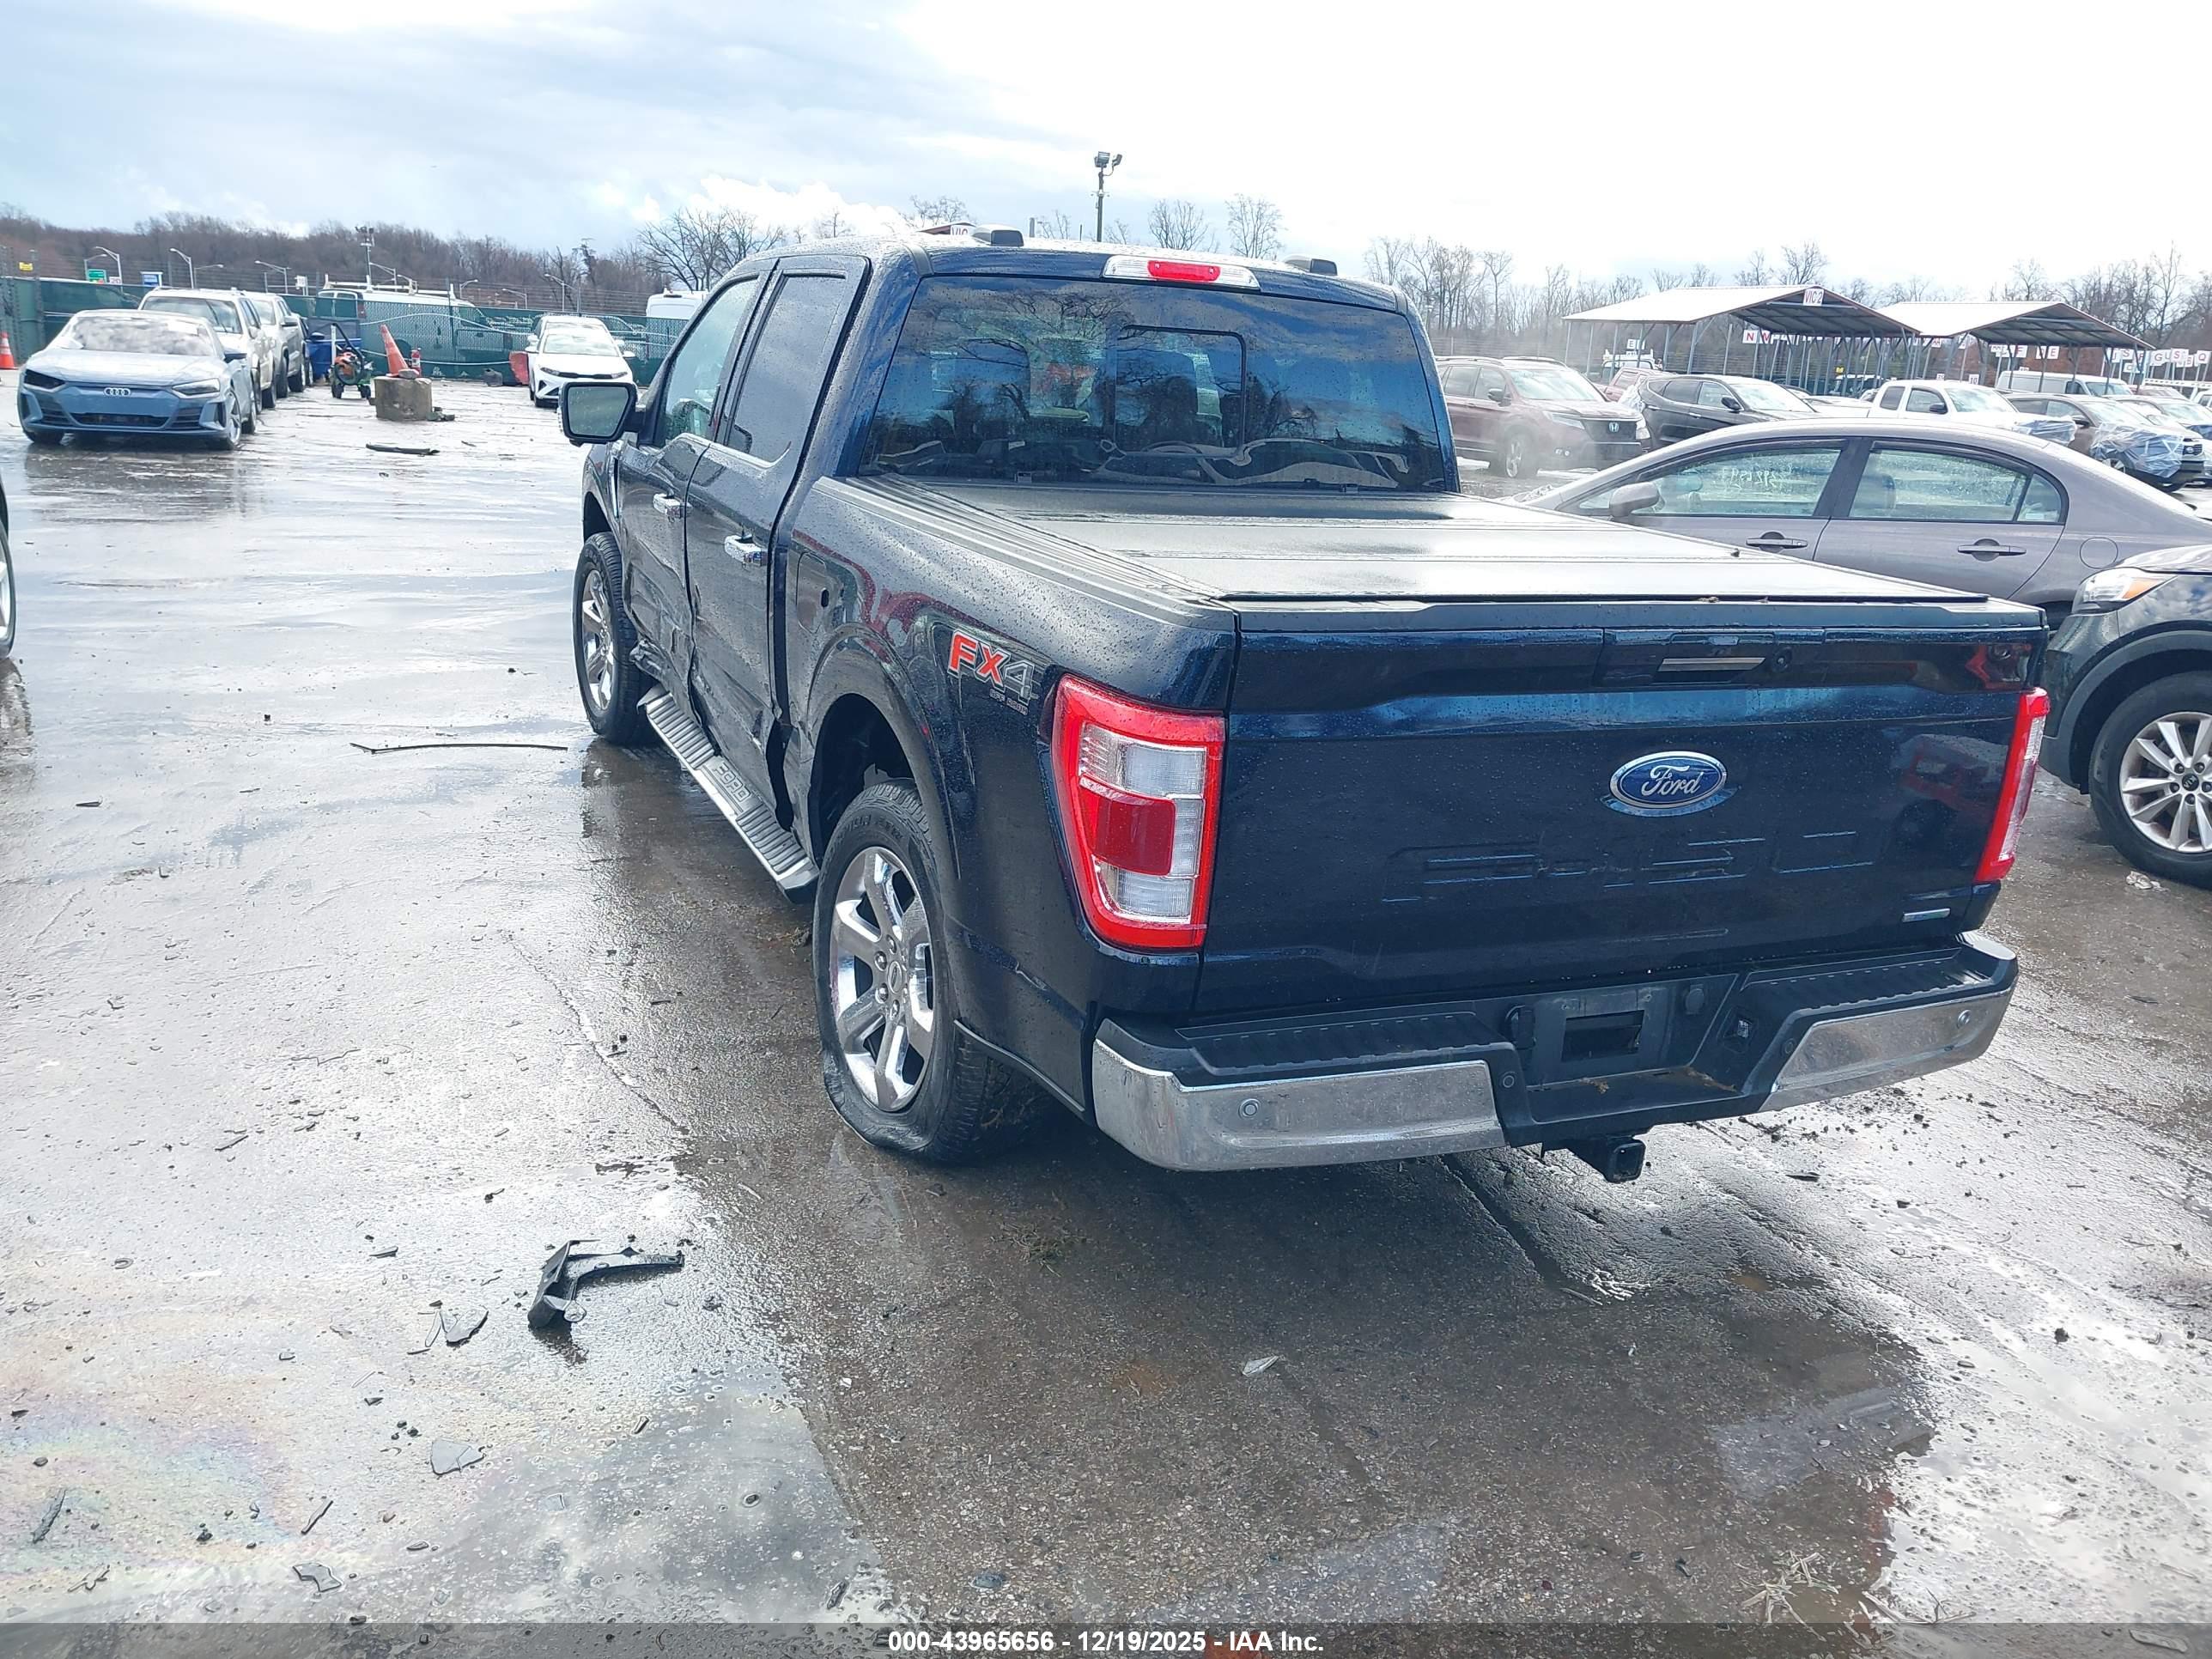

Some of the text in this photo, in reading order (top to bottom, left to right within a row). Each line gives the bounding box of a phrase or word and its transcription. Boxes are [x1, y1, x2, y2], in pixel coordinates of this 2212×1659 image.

[1747, 331, 1754, 342] N
[2051, 348, 2057, 357] E
[2154, 353, 2163, 362] G
[2173, 350, 2180, 359] S
[947, 629, 1035, 705] FX4
[1642, 765, 1705, 796] Ford
